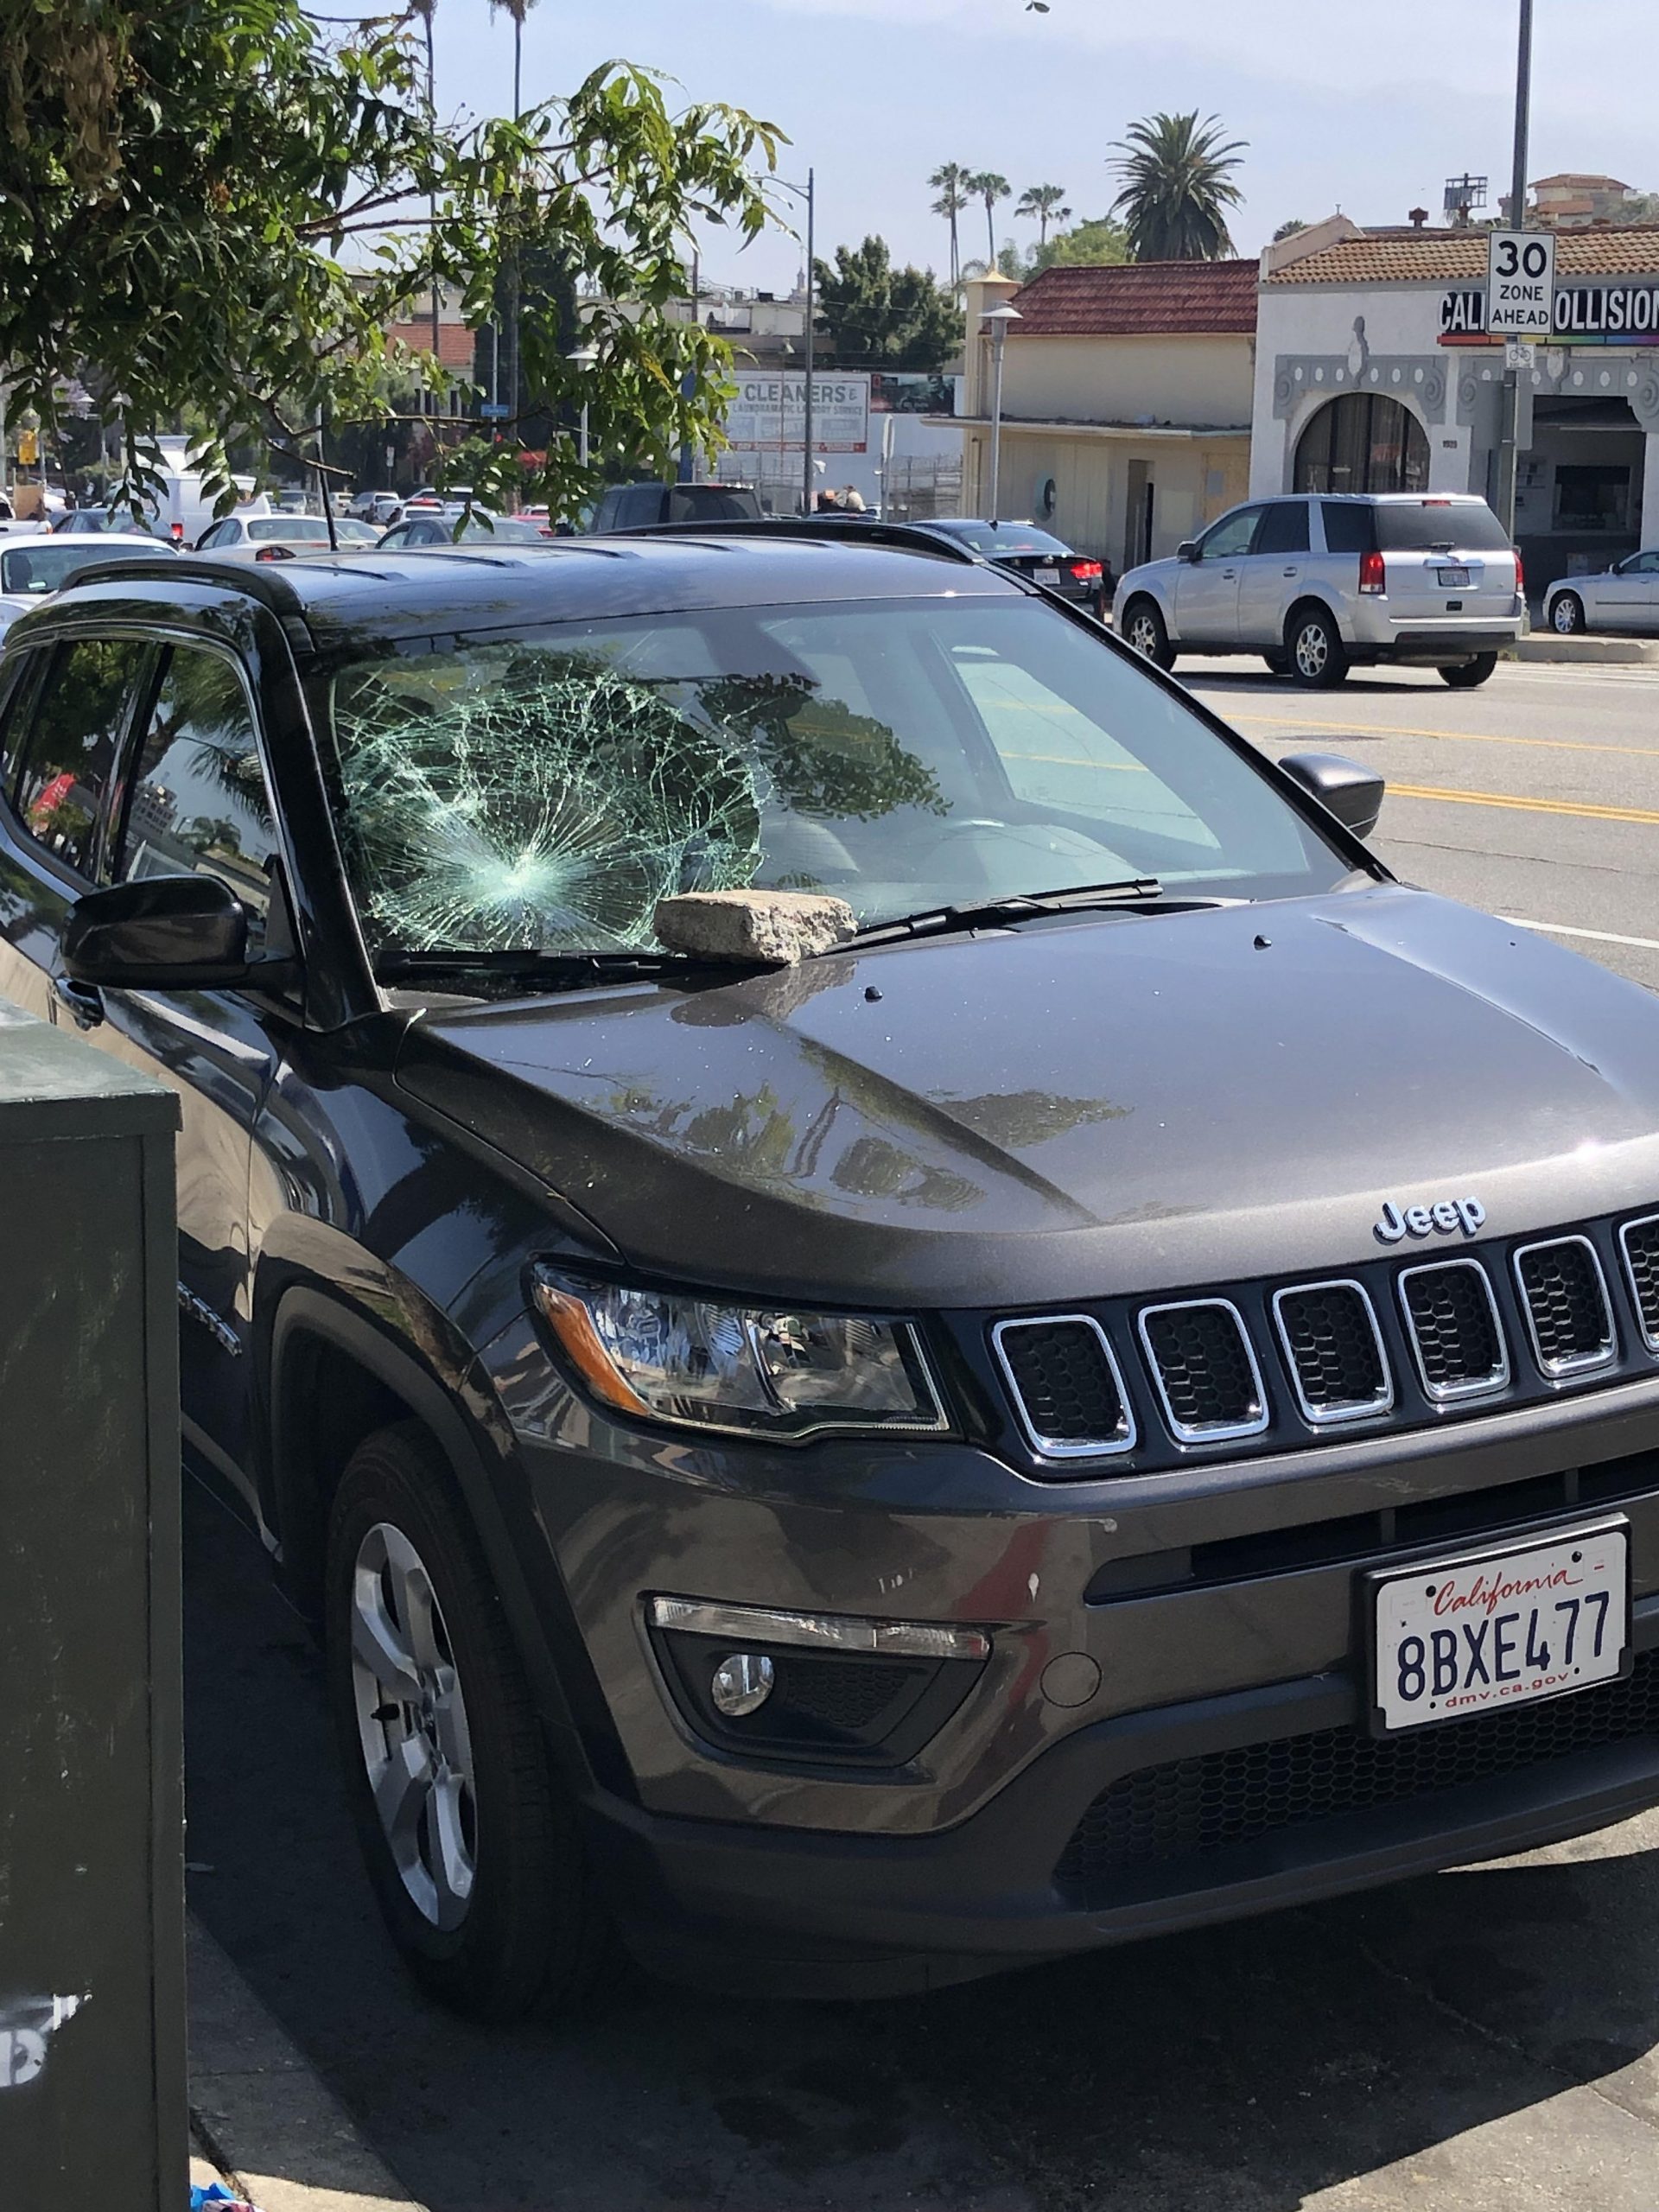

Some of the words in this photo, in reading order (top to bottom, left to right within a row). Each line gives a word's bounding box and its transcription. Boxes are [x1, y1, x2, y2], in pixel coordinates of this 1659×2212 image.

[1496, 240, 1547, 278] 30
[1438, 294, 1486, 331] CALI
[1555, 289, 1659, 330] OLLISIO
[1500, 284, 1543, 301] ZONE
[1491, 308, 1548, 325] AHEAD
[745, 384, 846, 403] CLEANERS
[1374, 1196, 1486, 1243] Jeep
[1433, 1562, 1583, 1616] California
[1397, 1591, 1610, 1701] 8BXE477
[1445, 1671, 1569, 1708] dmv.ca.gov
